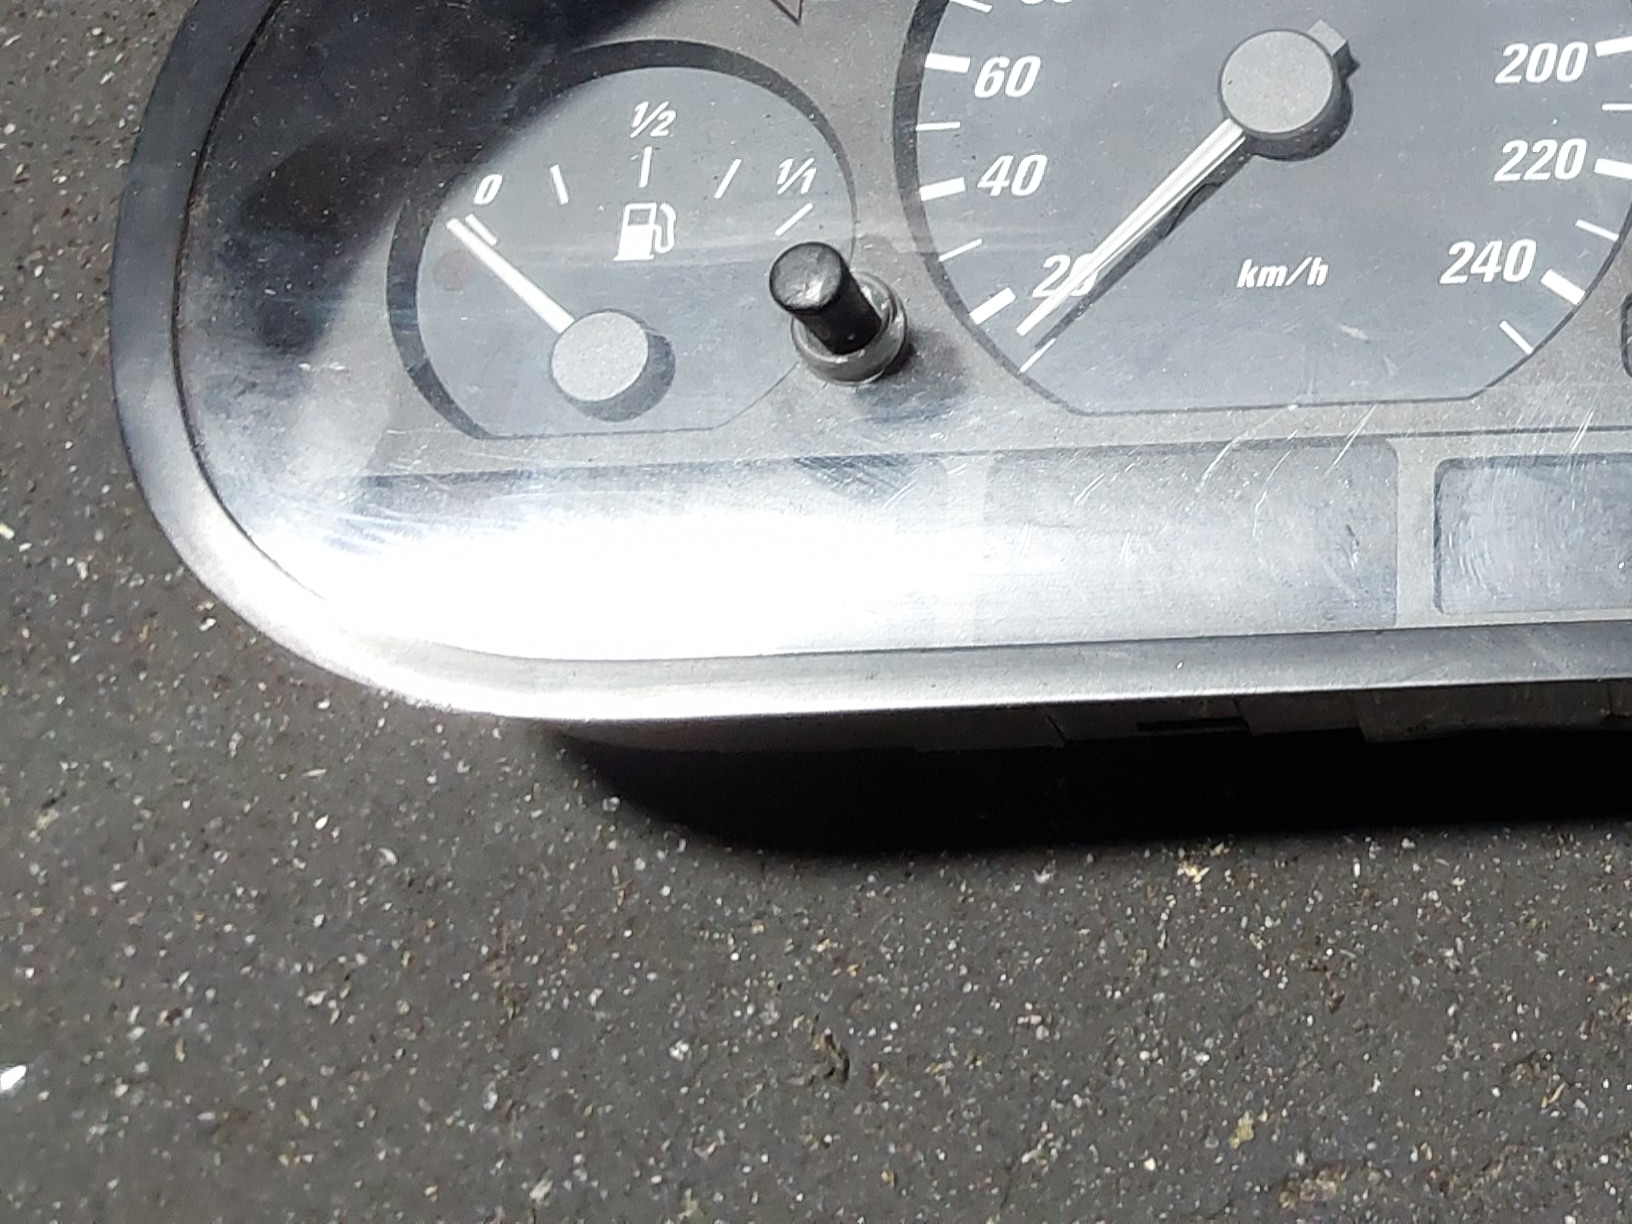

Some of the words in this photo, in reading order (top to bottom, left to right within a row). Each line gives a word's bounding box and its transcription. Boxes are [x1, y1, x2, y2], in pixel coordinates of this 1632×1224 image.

[974, 56, 1041, 97] 60
[1494, 42, 1588, 84] 200
[977, 155, 1048, 197] 40
[1494, 139, 1586, 182] 220
[473, 174, 503, 205] 0
[1237, 260, 1328, 288] km/h
[1439, 240, 1536, 284] 240
